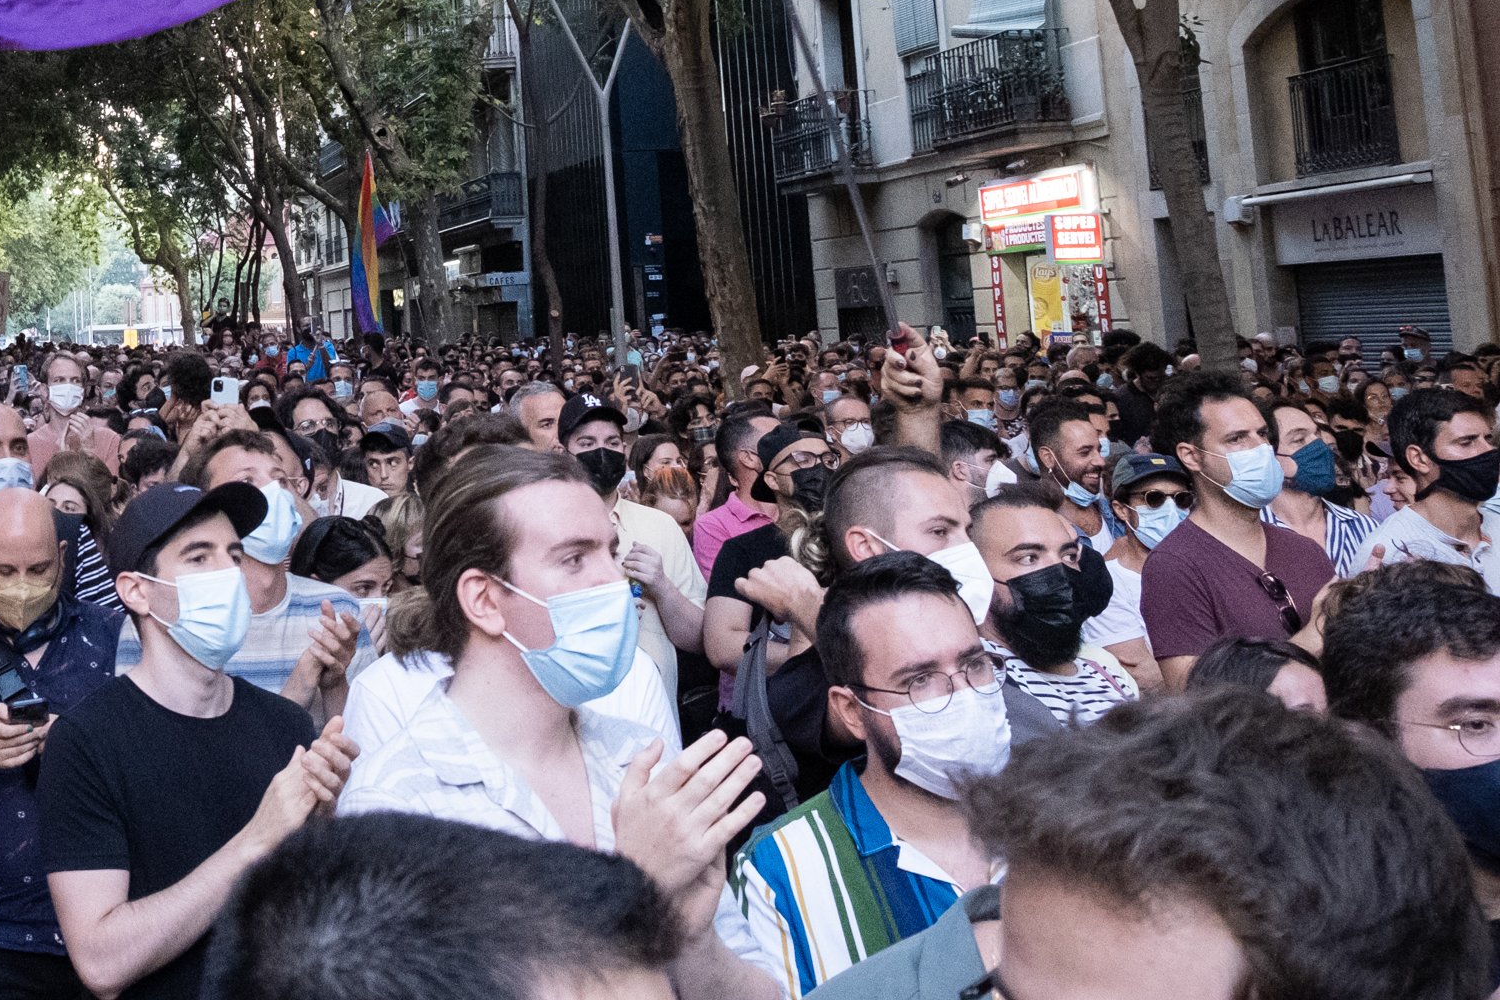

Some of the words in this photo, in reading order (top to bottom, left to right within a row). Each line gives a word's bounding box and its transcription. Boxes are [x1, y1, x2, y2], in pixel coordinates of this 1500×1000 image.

[1054, 216, 1096, 229] SUPER
[1333, 211, 1403, 240] BALEAR
[1009, 231, 1046, 246] PRODUCTES
[1057, 231, 1096, 245] SERVEI
[581, 393, 602, 408] LA
